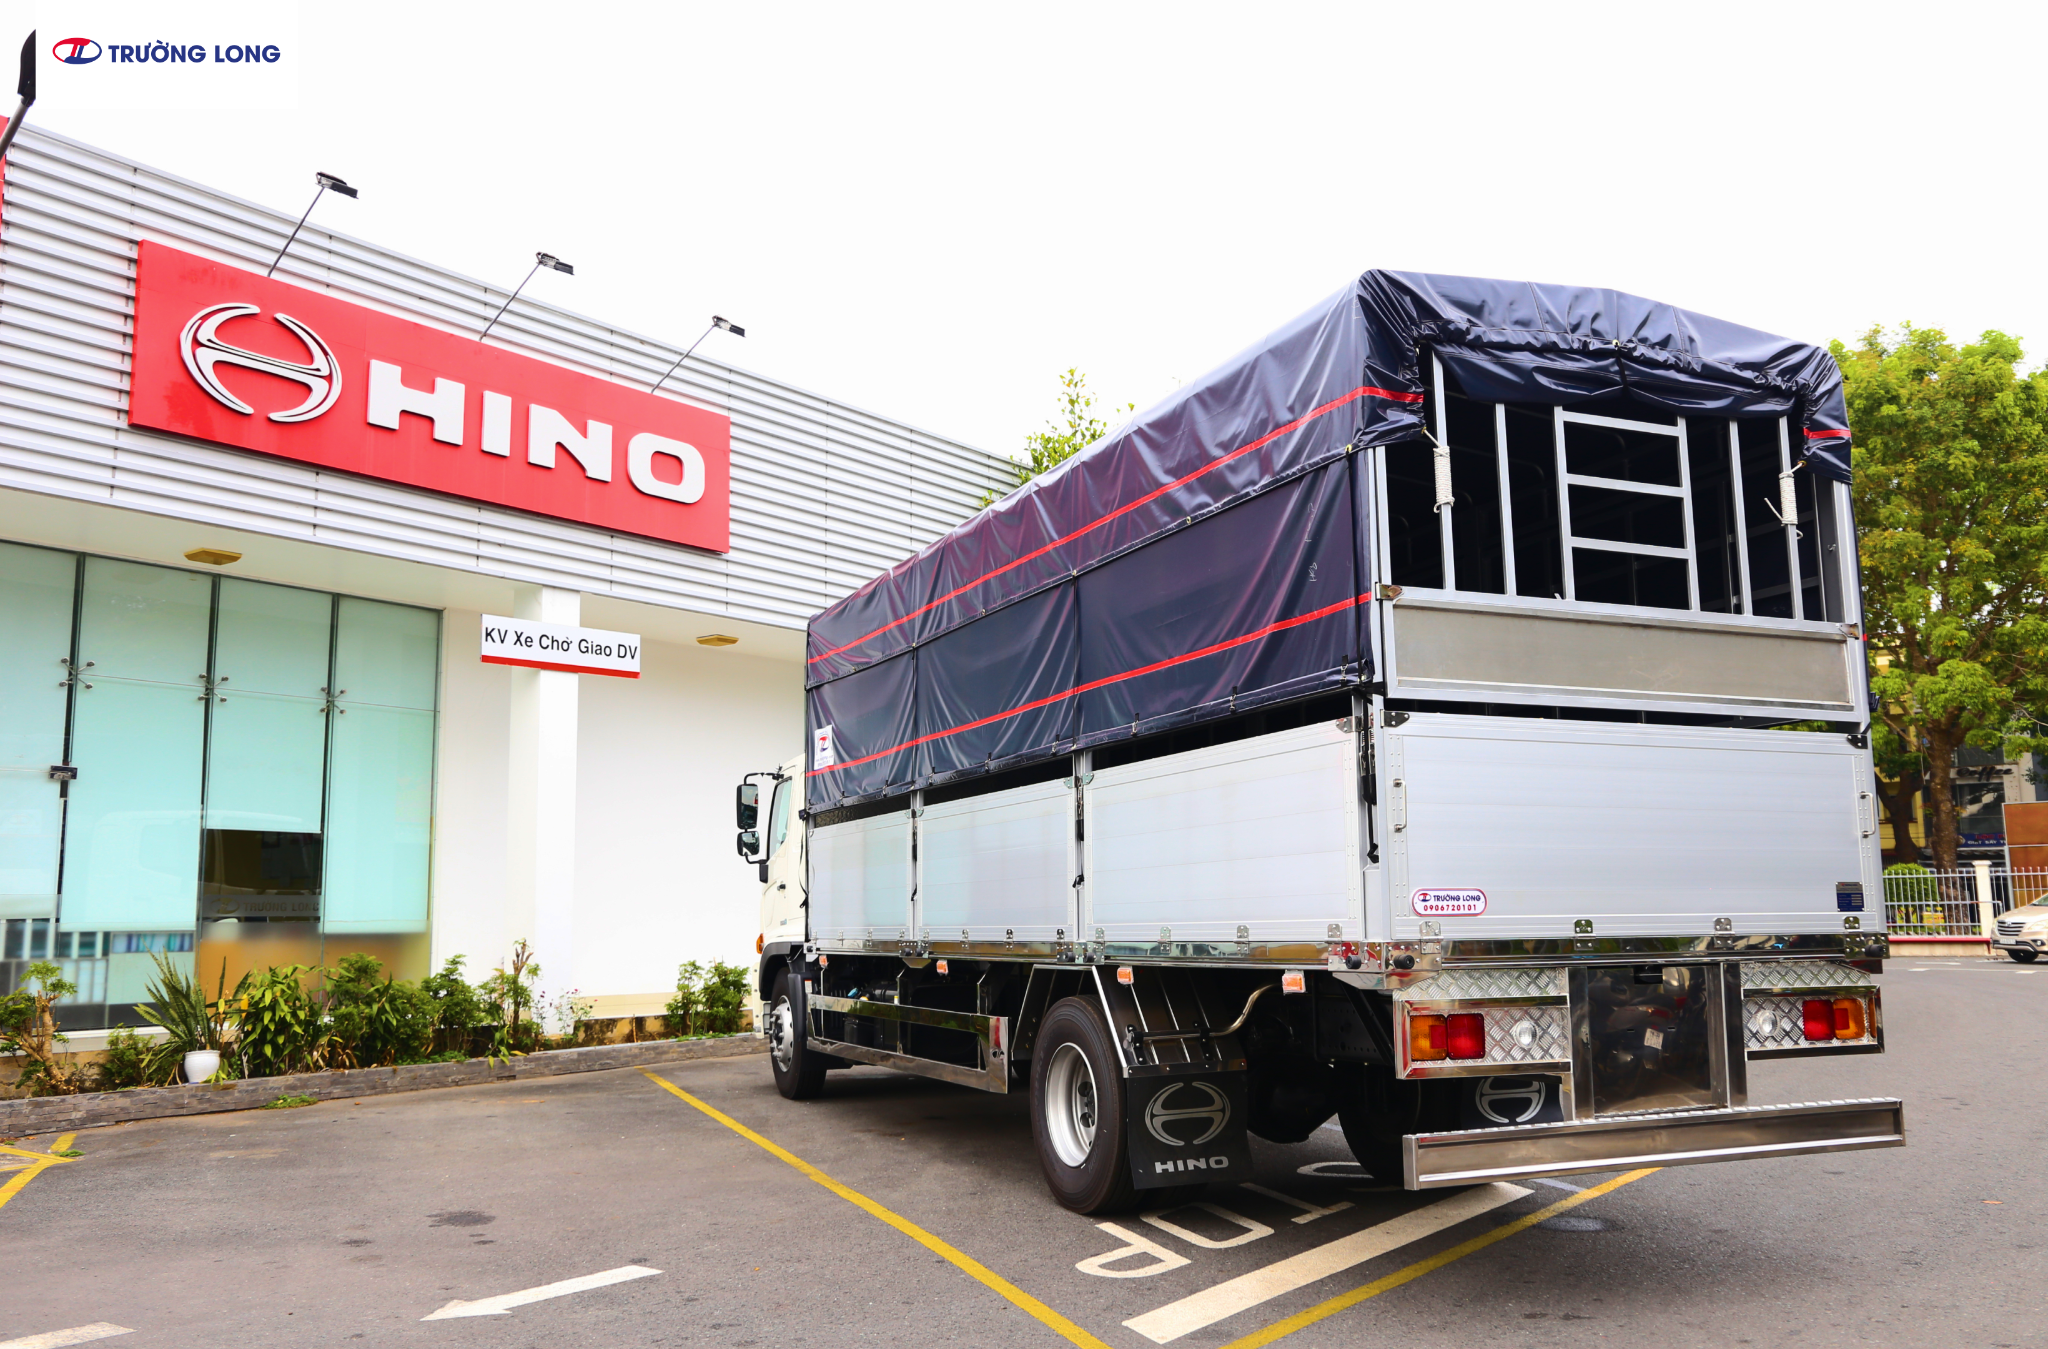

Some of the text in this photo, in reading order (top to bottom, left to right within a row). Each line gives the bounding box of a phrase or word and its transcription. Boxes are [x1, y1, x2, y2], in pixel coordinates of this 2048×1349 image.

[366, 359, 705, 504] HINO
[485, 627, 638, 660] KV Xe Chờ Giao DV
[1433, 893, 1461, 902] TRƯỜNG
[1154, 1156, 1229, 1174] HINO
